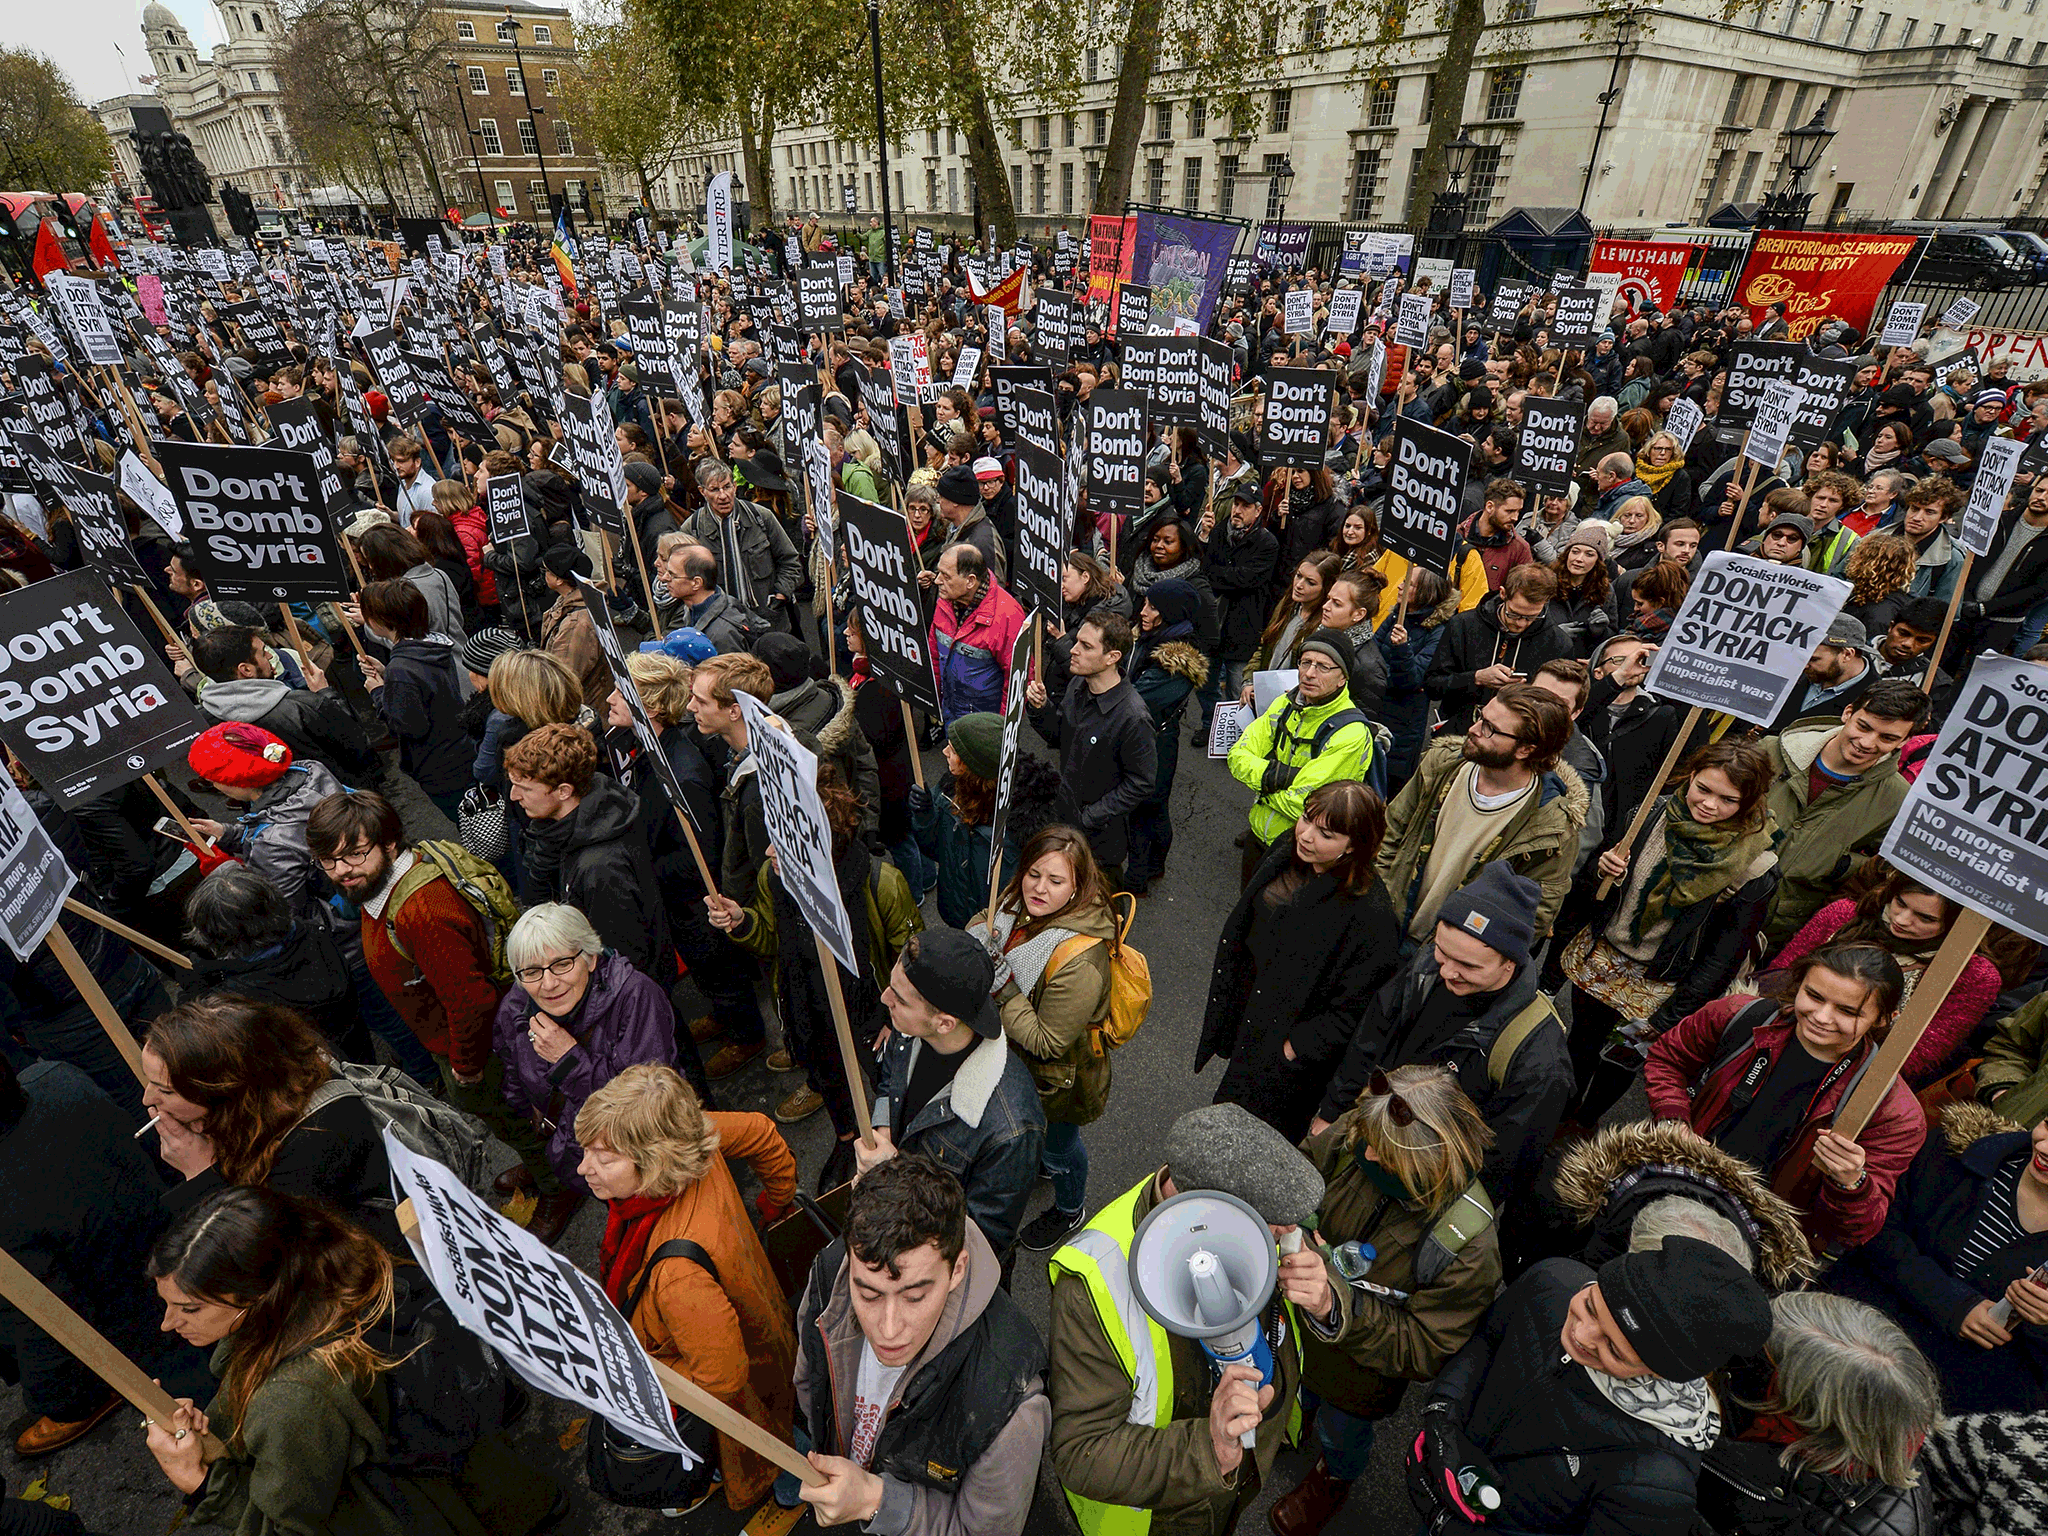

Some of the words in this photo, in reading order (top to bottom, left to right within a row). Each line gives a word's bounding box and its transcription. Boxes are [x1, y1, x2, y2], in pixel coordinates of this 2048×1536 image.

[714, 188, 728, 272] NTERFIRE
[1600, 247, 1685, 265] LEWISHAM
[1755, 238, 1822, 255] BRENTFORD
[1838, 241, 1911, 255] ISLEWORTH
[1152, 241, 1211, 277] UNISON
[1771, 256, 1818, 271] LABOUR
[1819, 257, 1859, 271] PARTY
[800, 276, 835, 291] Don't
[1452, 280, 1472, 288] ATTACK
[1499, 285, 1522, 298] Don't
[1627, 266, 1650, 278] THE
[1649, 277, 1662, 304] WAR
[800, 290, 837, 304] Bomb
[1039, 298, 1069, 319] Don't
[1122, 292, 1148, 307] Don't
[1286, 303, 1311, 311] ATTACK
[1287, 296, 1306, 305] DON'T
[1402, 301, 1424, 312] DON'T
[1494, 296, 1520, 309] Bomb
[1560, 297, 1595, 309] Don't
[1956, 300, 1976, 313] DON'T
[235, 308, 265, 326] Don't
[666, 310, 698, 325] Don't
[804, 302, 836, 319] Syria
[1120, 304, 1148, 319] Bomb
[1400, 310, 1427, 323] ATTACK
[1492, 308, 1515, 321] Syria
[1556, 309, 1594, 322] Bomb
[1890, 316, 1917, 324] BOMB
[1892, 308, 1921, 317] DON'T
[1948, 310, 1965, 322] SYRIA
[1952, 305, 1971, 318] BOMB
[243, 326, 278, 341] Bomb
[629, 314, 662, 334] Don't
[664, 324, 699, 340] Bomb
[1036, 316, 1069, 335] Bomb
[1120, 317, 1145, 332] Syria
[1399, 318, 1420, 330] SYRIA
[1555, 321, 1588, 335] Syria
[1887, 322, 1915, 331] SYRIA
[254, 340, 284, 354] Syria
[370, 340, 401, 366] Don't
[632, 335, 665, 355] Bomb
[1037, 333, 1066, 351] Syria
[637, 352, 670, 374] Syria
[1125, 346, 1156, 363] Don'
[1159, 348, 1198, 366] Don't
[1736, 353, 1794, 373] Don't
[1935, 355, 1974, 377] Don't
[378, 360, 411, 385] Bomb
[413, 364, 452, 385] Don't
[1122, 364, 1155, 382] Bom
[1156, 366, 1199, 385] Bomb
[1201, 353, 1230, 386] Don't
[1797, 368, 1847, 392] Don't
[21, 372, 54, 399] Don't
[389, 381, 418, 404] Syria
[424, 381, 467, 406] Bomb
[922, 384, 950, 402] BLIND
[1158, 385, 1196, 405] Syria
[1200, 376, 1229, 411] Bomb
[1272, 381, 1327, 402] Don't
[1764, 389, 1790, 407] DON'T
[1800, 390, 1839, 410] omb
[30, 397, 66, 424] Bomb
[438, 403, 478, 425] Syria
[1019, 402, 1053, 431] Don't
[1093, 406, 1141, 431] Don't
[1200, 402, 1227, 434] Syria
[1267, 401, 1327, 424] Bomb
[1527, 409, 1577, 433] Don't
[1758, 403, 1791, 424] ATTACK
[1797, 410, 1827, 428] yria
[43, 422, 76, 450] Syria
[569, 411, 600, 446] Don't
[1268, 423, 1321, 445] Syria
[1755, 418, 1778, 435] SYRIA
[1090, 432, 1143, 457] Bomb
[1521, 429, 1575, 453] Bomb
[312, 450, 332, 474] mb
[573, 438, 608, 470] Bomb
[1399, 438, 1460, 487] Don't
[1521, 449, 1568, 474] Syria
[579, 462, 612, 500] Syria
[1092, 457, 1139, 485] Syria
[180, 467, 309, 502] Don't
[321, 472, 341, 504] yria
[491, 484, 519, 499] Don't
[1018, 458, 1059, 513] Don't
[1391, 465, 1457, 515] Bomb
[492, 497, 521, 513] Bomb
[185, 502, 322, 534] Bomb
[495, 510, 521, 524] Syria
[1018, 492, 1061, 551] Bomb
[1391, 494, 1449, 542] Syria
[208, 535, 326, 569] Syria
[846, 521, 908, 584] Don't
[1019, 528, 1058, 583] Syria
[1726, 561, 1779, 583] Socialist
[1779, 573, 1824, 593] Worker
[851, 562, 918, 626] Bomb
[1699, 571, 1808, 616] DON'T
[1686, 598, 1818, 650] ATTACK
[862, 605, 923, 667] Syria
[1676, 621, 1769, 665] SYRIA
[1670, 649, 1689, 663] No
[1692, 658, 1729, 674] more
[1664, 661, 1738, 690] imperialist
[1740, 683, 1775, 701] wars
[1216, 712, 1227, 748] CORBYN
[748, 721, 801, 802] DON'T
[759, 766, 827, 860] ATTACK
[764, 795, 816, 879] SYRIA
[1915, 803, 1947, 831] No
[1951, 824, 2016, 863] more
[1907, 820, 2030, 894] imperialist
[4, 861, 27, 892] more
[1899, 846, 2016, 916] www.swp.org.uk
[1, 866, 44, 923] imperialist
[1745, 1057, 1768, 1086] Canon
[1834, 1059, 1851, 1076] EOS
[439, 1186, 530, 1359] DON'T
[440, 1219, 473, 1304] Socialist
[467, 1192, 576, 1390] ATTACK
[529, 1260, 615, 1409] SYRIA
[594, 1322, 621, 1386] more
